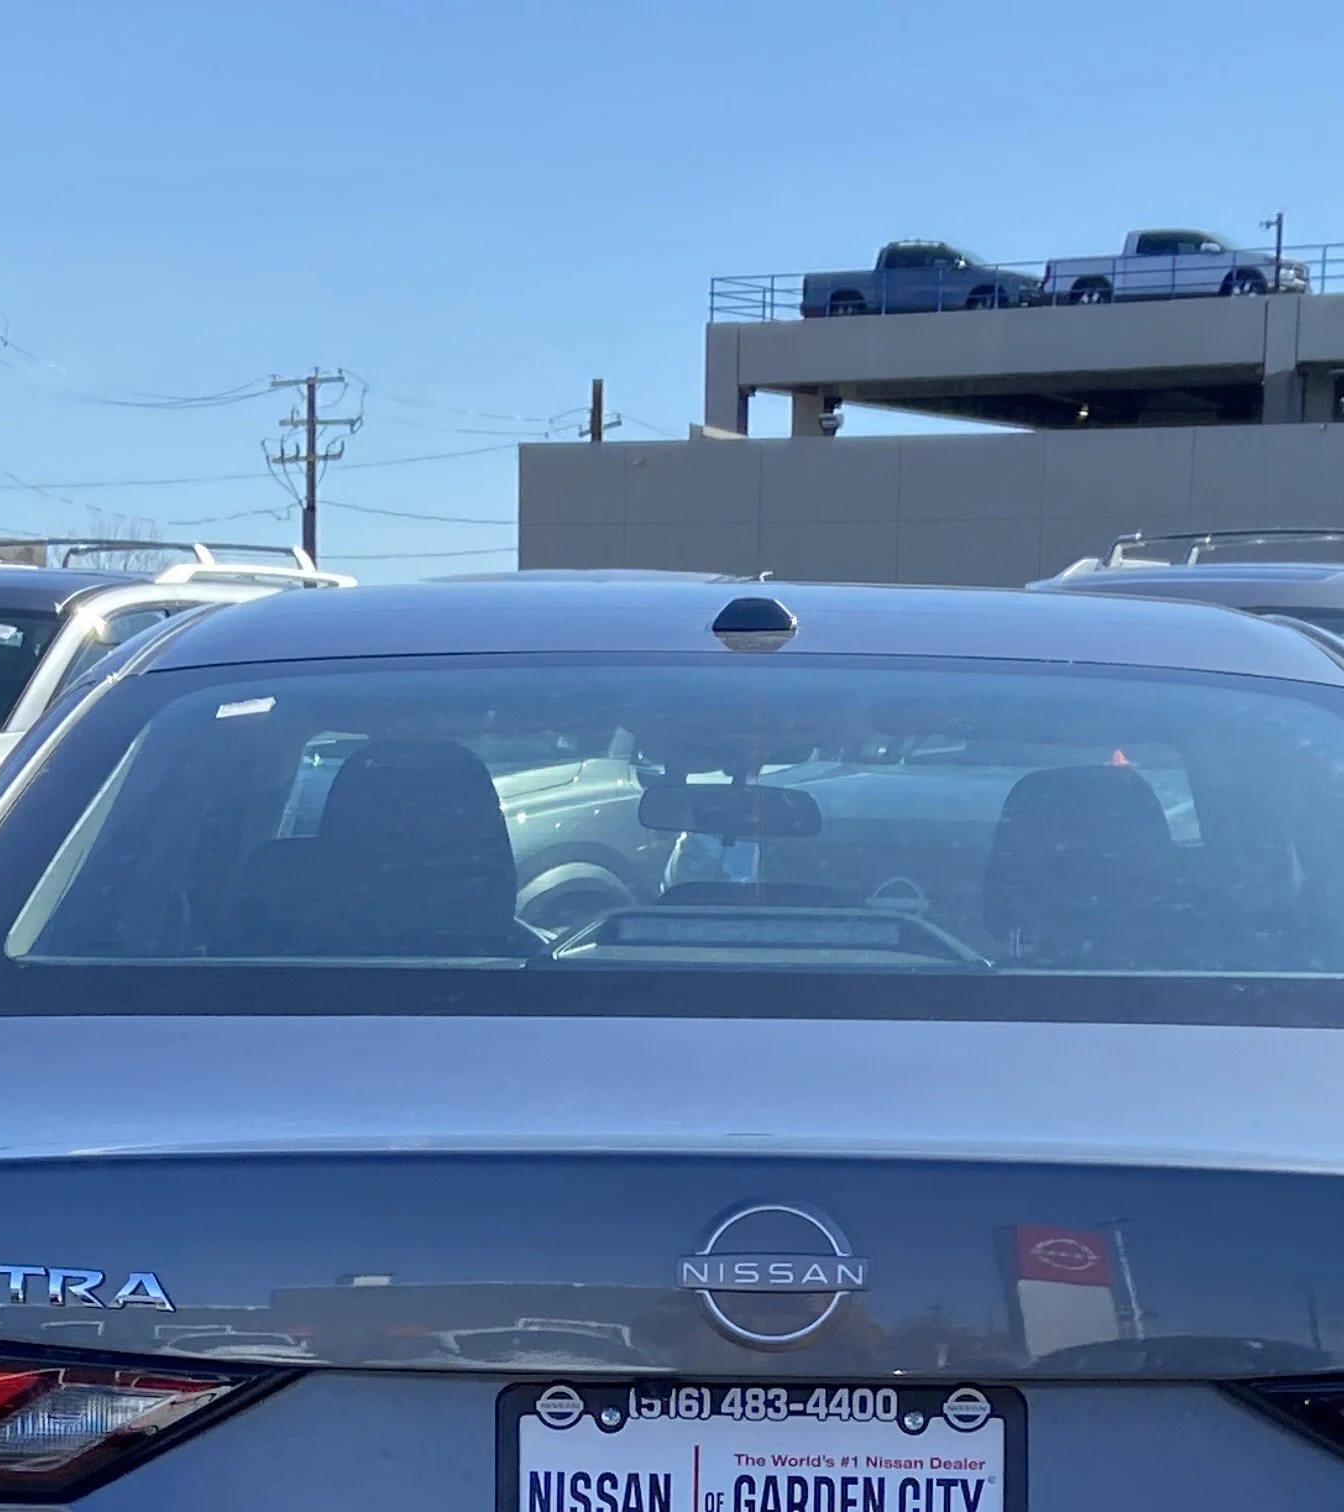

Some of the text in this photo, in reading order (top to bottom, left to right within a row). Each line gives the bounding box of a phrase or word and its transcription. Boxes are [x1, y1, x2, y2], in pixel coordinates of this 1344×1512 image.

[682, 1261, 864, 1287] NISSAN
[628, 1386, 899, 1423] (516) 483-4400
[733, 1453, 987, 1472] The World's #1 Nissan Dealer
